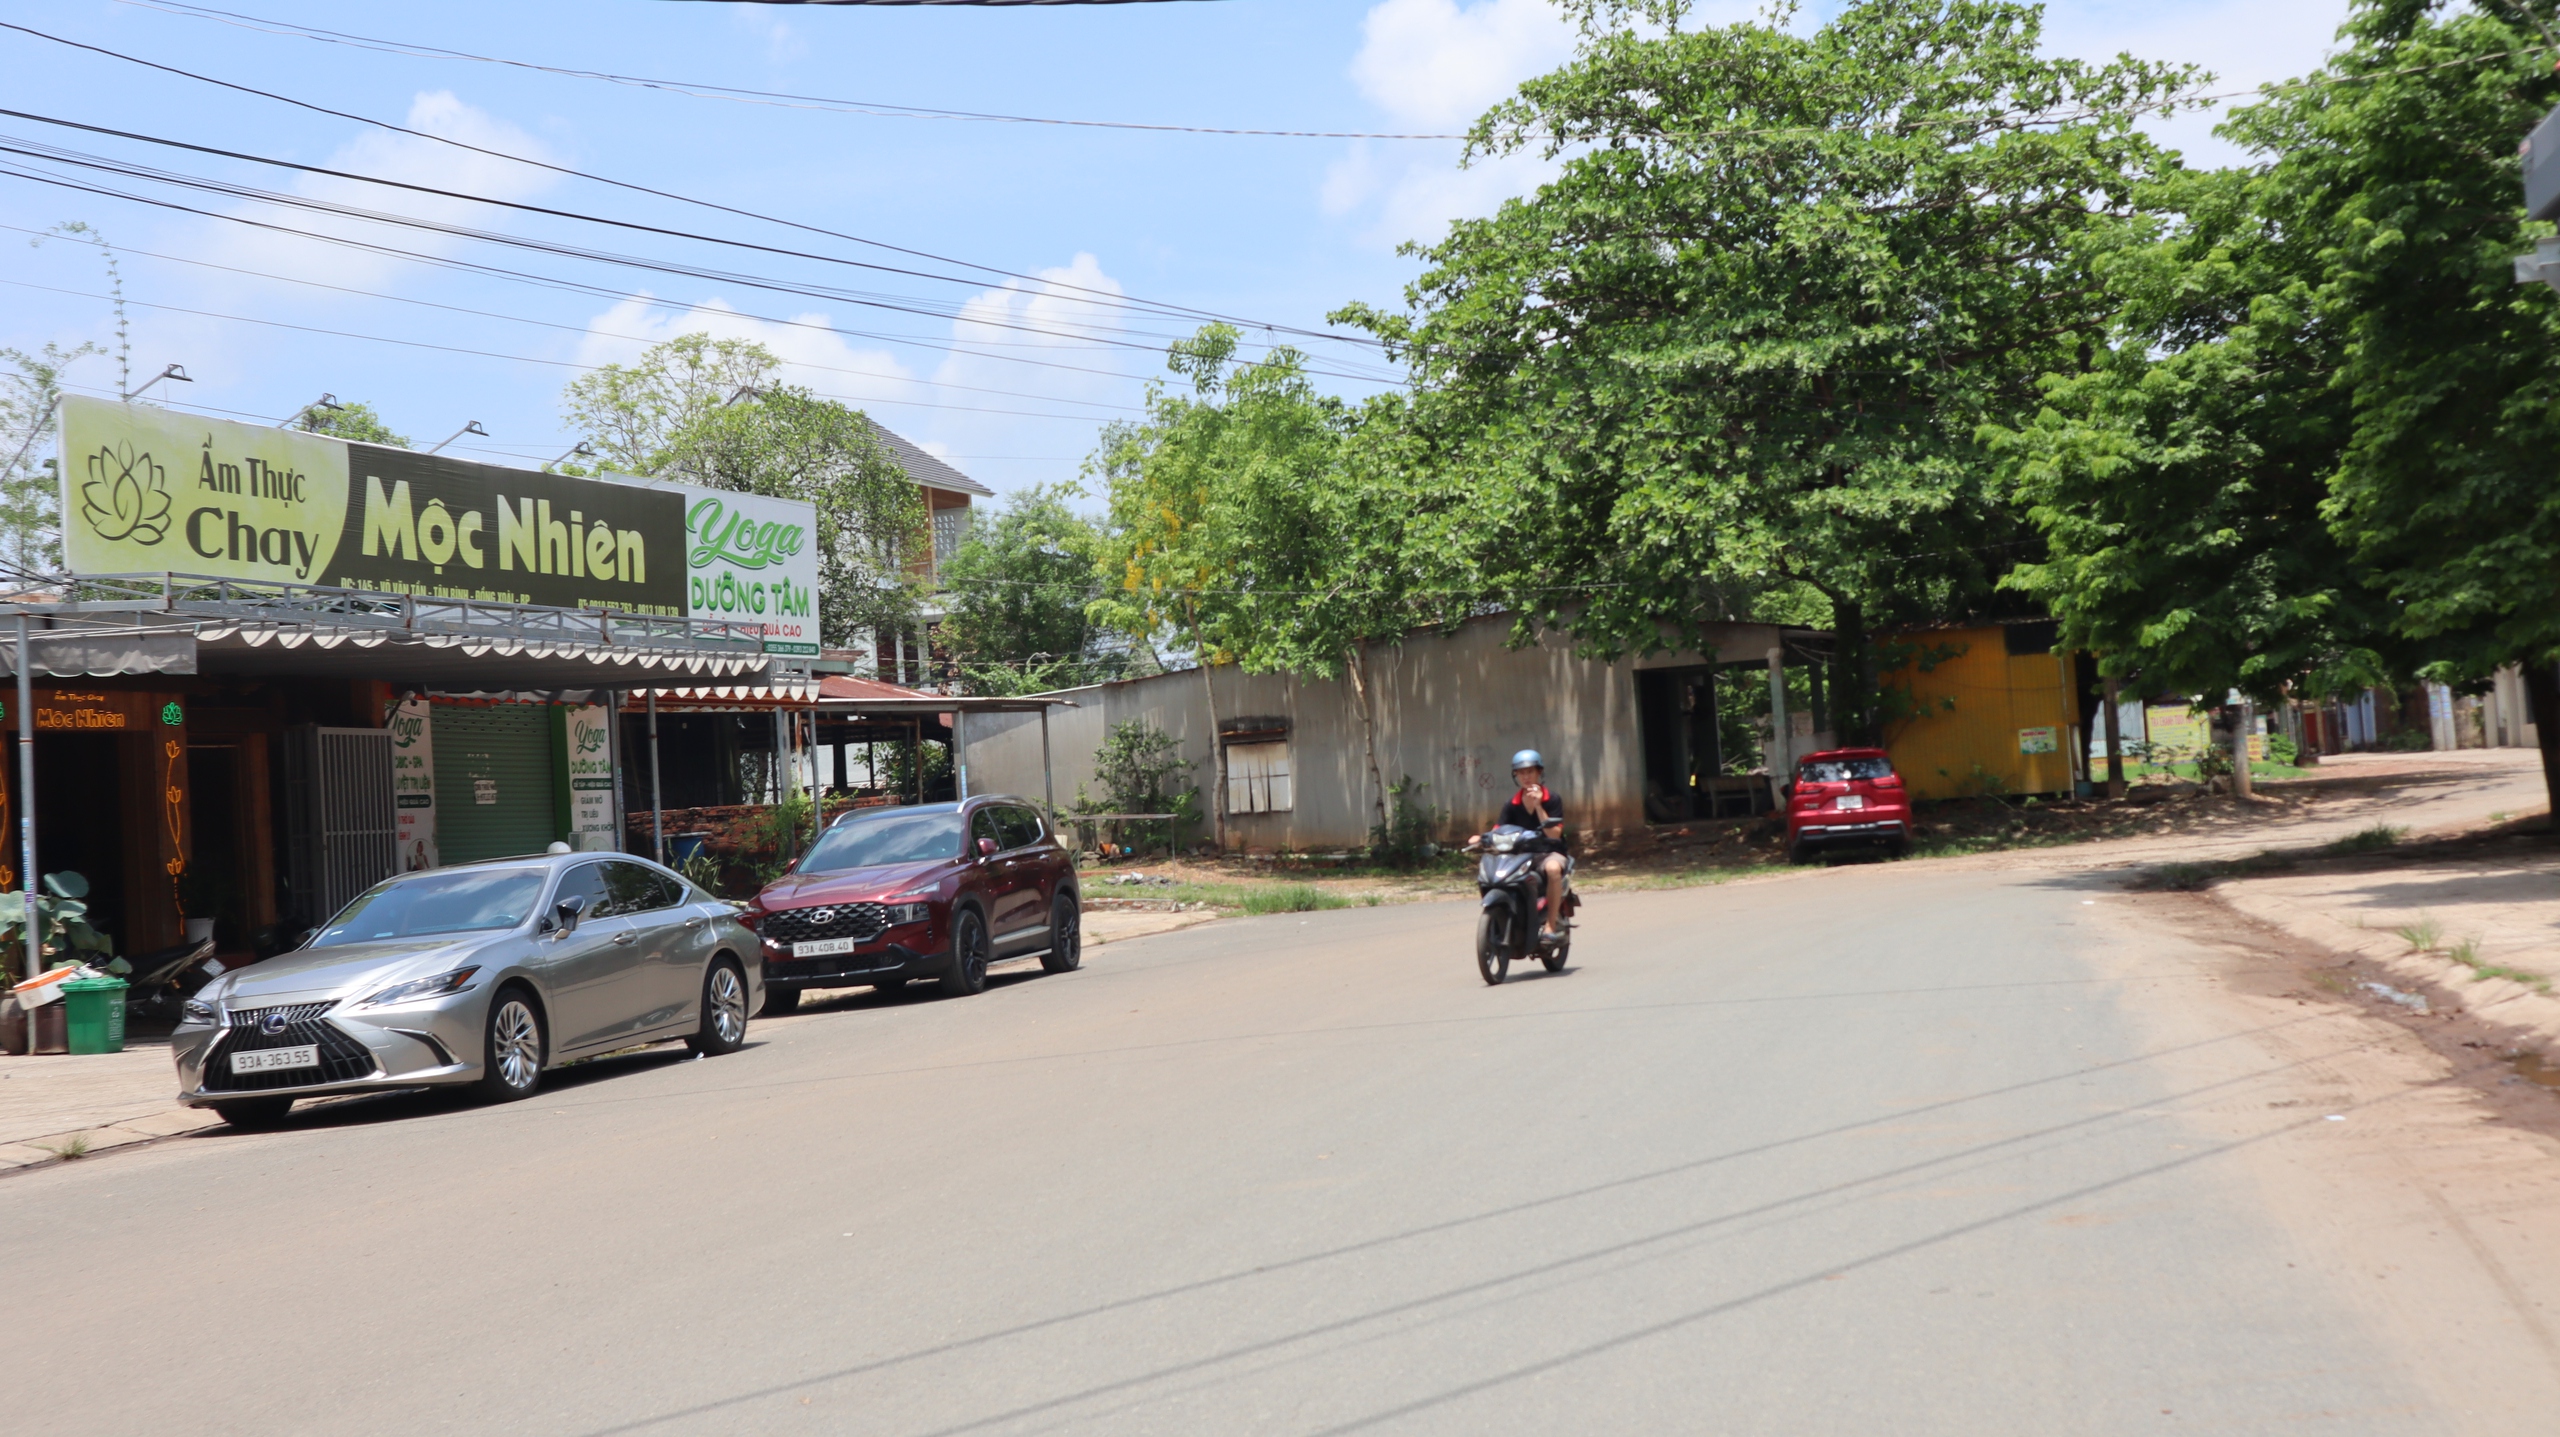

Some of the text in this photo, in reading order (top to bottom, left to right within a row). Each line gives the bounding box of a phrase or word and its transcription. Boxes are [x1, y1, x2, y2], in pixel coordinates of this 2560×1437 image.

[199, 432, 306, 508] Ẩm Thực
[186, 507, 319, 580] Chay
[362, 475, 646, 584] Mộc Nhiên
[685, 497, 805, 571] Yoga
[691, 570, 810, 618] DƯỠNG TÂM
[763, 618, 781, 637] QUẢ
[782, 623, 803, 638] CAO
[75, 708, 125, 728] Nhiên
[574, 719, 607, 755] Yoga
[797, 941, 849, 955] 93A-408.40
[238, 1050, 310, 1070] 93A-363.55
